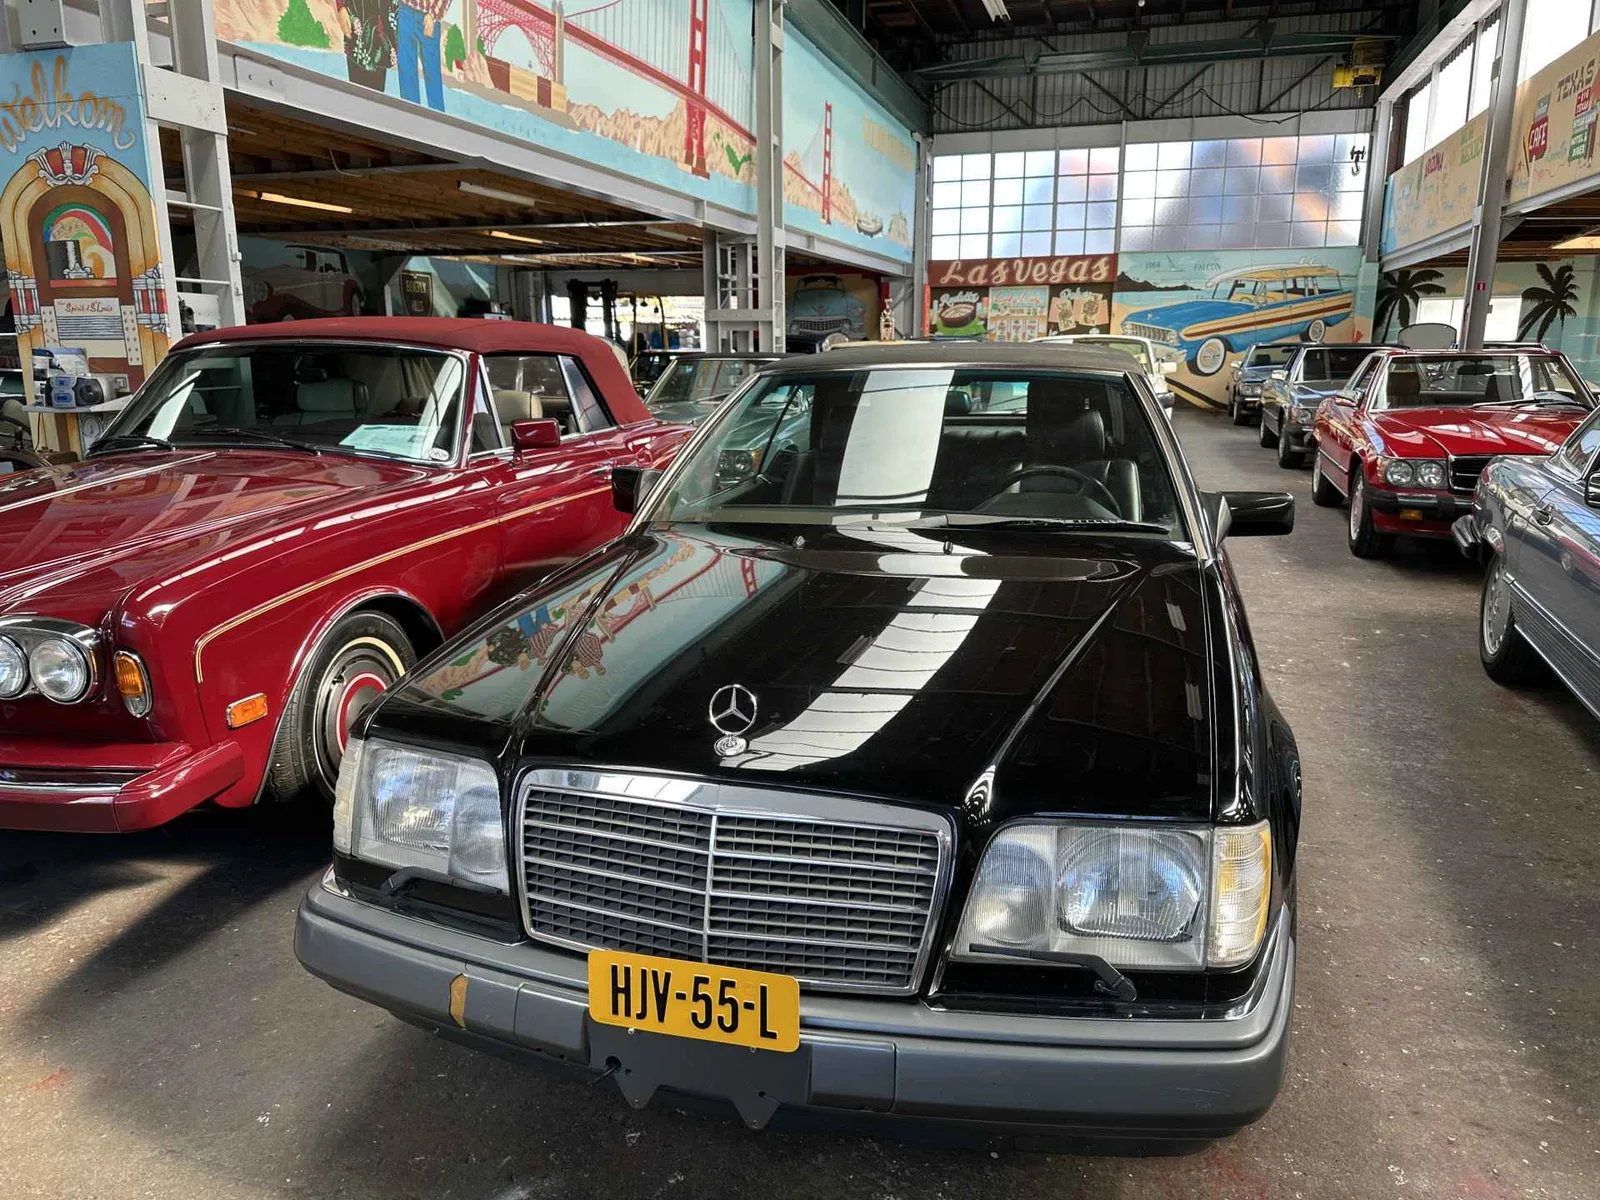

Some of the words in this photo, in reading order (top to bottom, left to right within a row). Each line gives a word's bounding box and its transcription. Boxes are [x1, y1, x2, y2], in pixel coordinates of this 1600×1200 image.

[1556, 58, 1596, 102] TEXAS
[1529, 122, 1548, 150] CAFE
[940, 260, 1009, 285] Las
[1012, 256, 1111, 283] Vegas
[610, 964, 778, 1040] HJV-55-L
